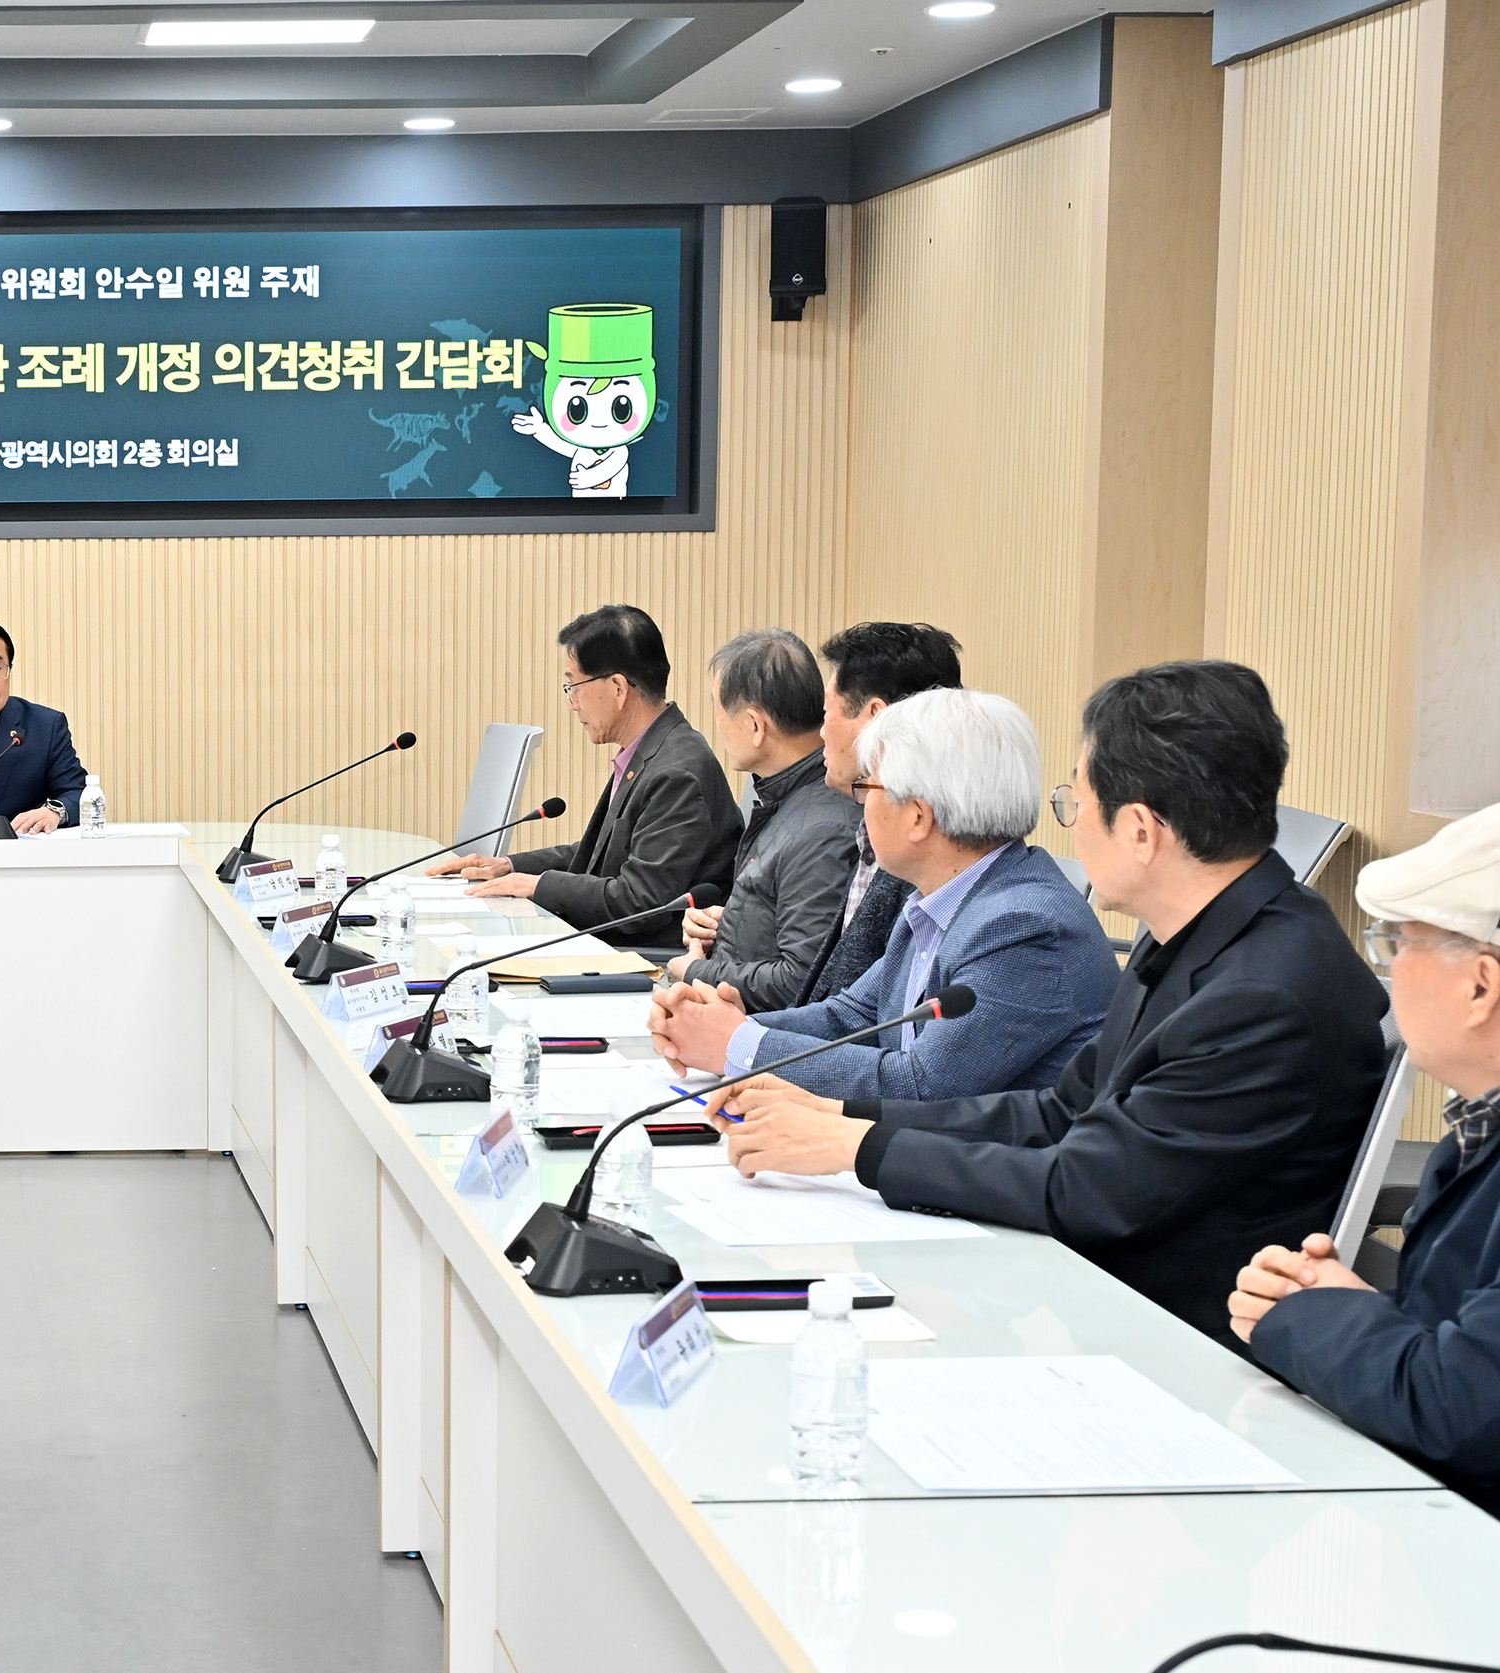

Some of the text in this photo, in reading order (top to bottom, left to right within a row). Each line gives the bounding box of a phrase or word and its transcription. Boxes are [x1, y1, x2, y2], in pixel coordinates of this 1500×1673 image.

[95, 266, 183, 300] 안수일
[192, 265, 250, 299] 위원
[260, 264, 320, 298] 주재
[16, 342, 105, 393] 조례
[115, 342, 201, 393] 개정
[211, 340, 384, 392] 의견청취
[395, 338, 524, 390] 간담회
[123, 439, 163, 468] 2층
[166, 438, 239, 467] 회의실
